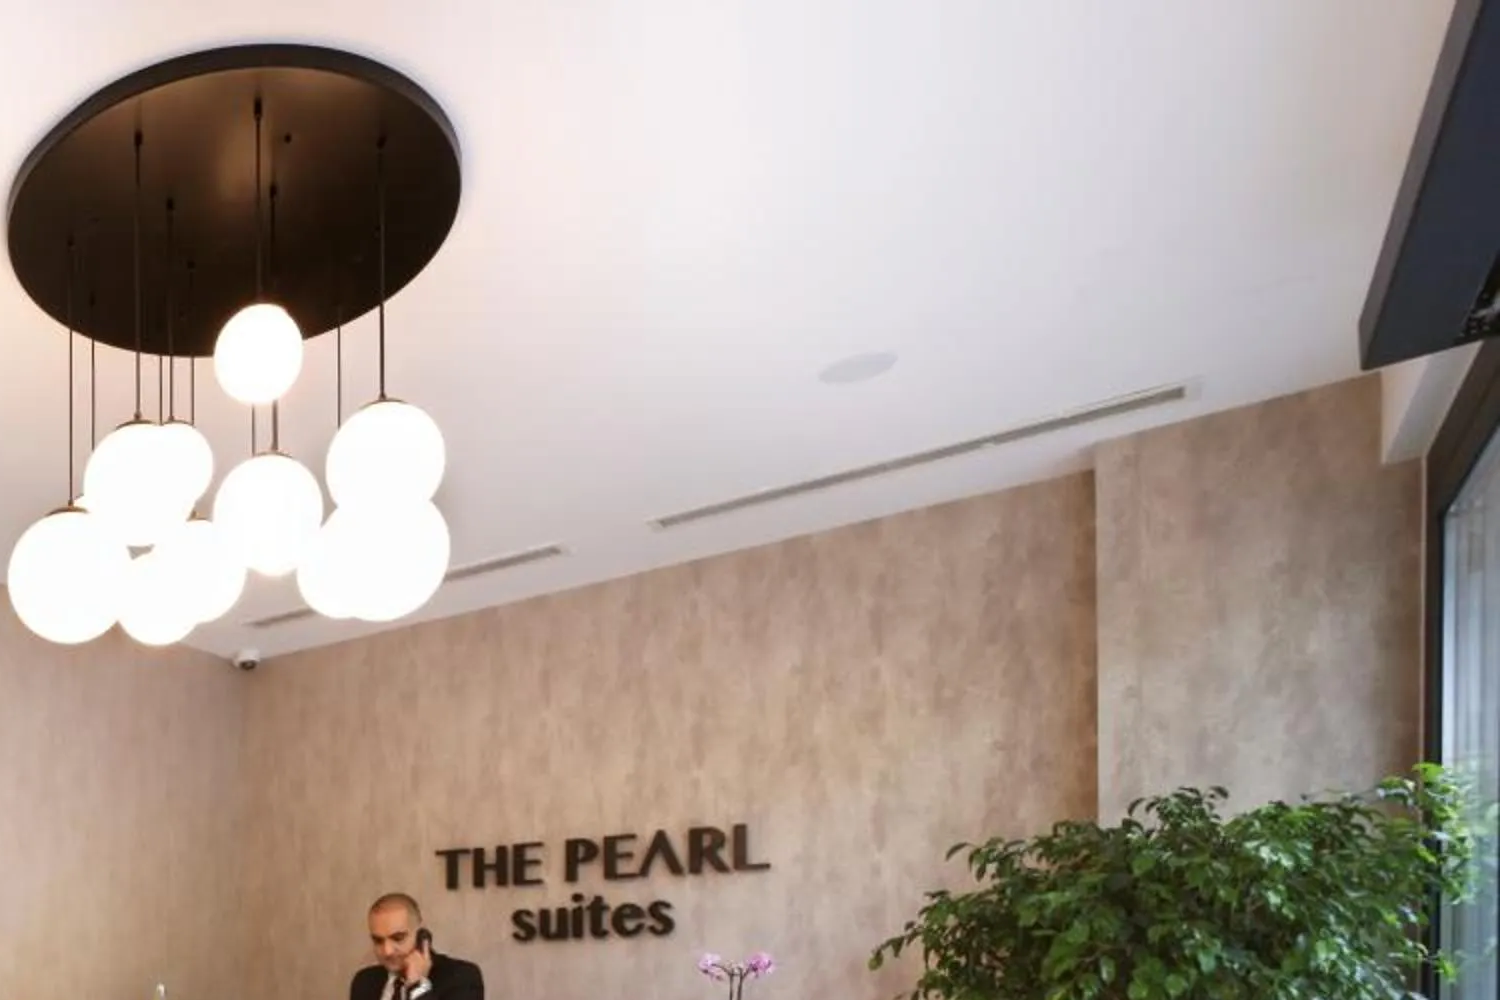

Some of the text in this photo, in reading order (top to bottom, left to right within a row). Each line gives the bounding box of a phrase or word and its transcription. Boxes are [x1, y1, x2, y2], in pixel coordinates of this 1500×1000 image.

[435, 823, 771, 890] THE PEARL
[511, 893, 675, 942] suites
